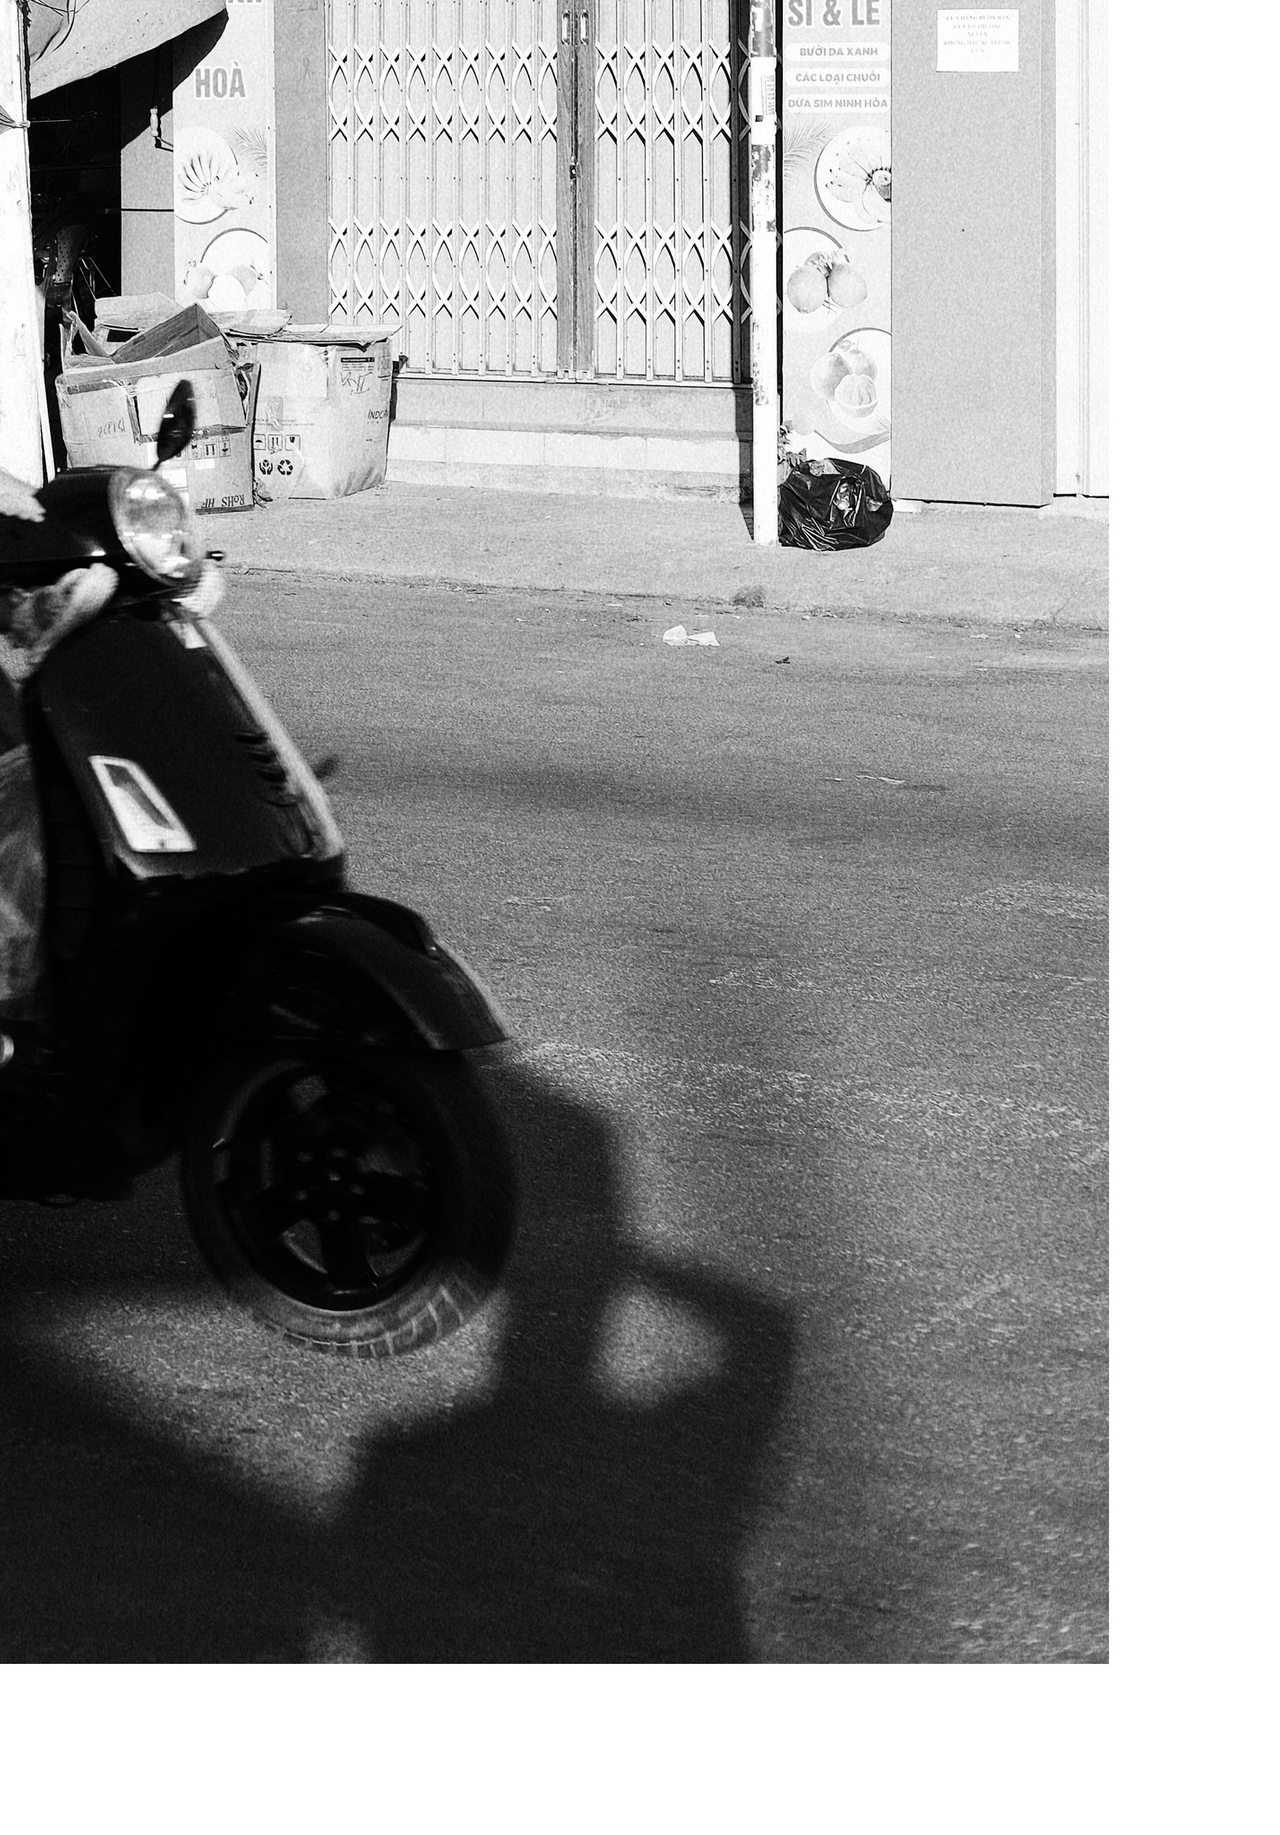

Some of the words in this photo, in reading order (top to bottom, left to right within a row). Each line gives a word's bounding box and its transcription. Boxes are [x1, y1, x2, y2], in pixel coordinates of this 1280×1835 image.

[829, 48, 844, 56] DA
[847, 47, 878, 56] XANH
[194, 61, 246, 100] HOÀ
[796, 71, 817, 82] CÁC
[819, 74, 844, 85] LOẠI
[814, 99, 832, 108] SIM
[835, 99, 862, 108] NINH
